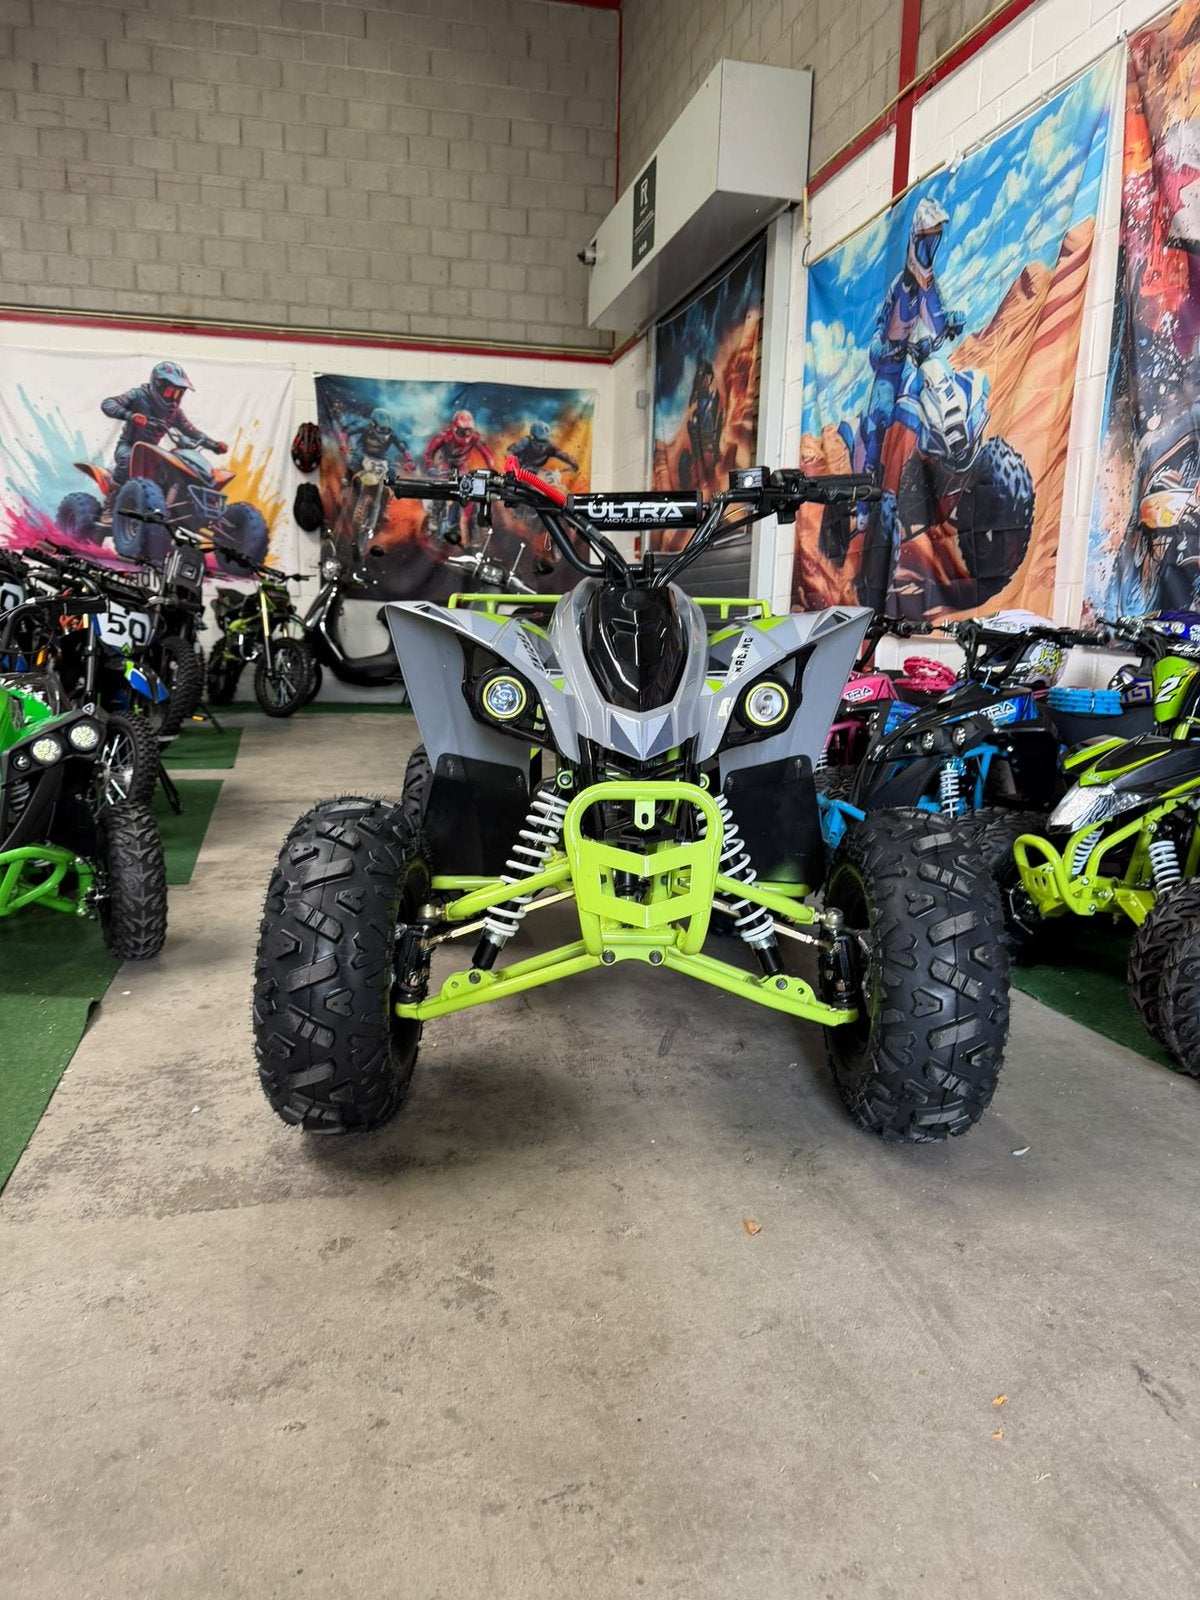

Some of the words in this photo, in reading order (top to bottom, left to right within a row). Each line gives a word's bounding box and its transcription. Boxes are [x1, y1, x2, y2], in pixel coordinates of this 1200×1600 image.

[587, 501, 684, 518] ULTRA
[107, 612, 148, 644] 50
[844, 686, 872, 699] TRA
[1155, 674, 1184, 704] 2
[979, 702, 1016, 719] TRA
